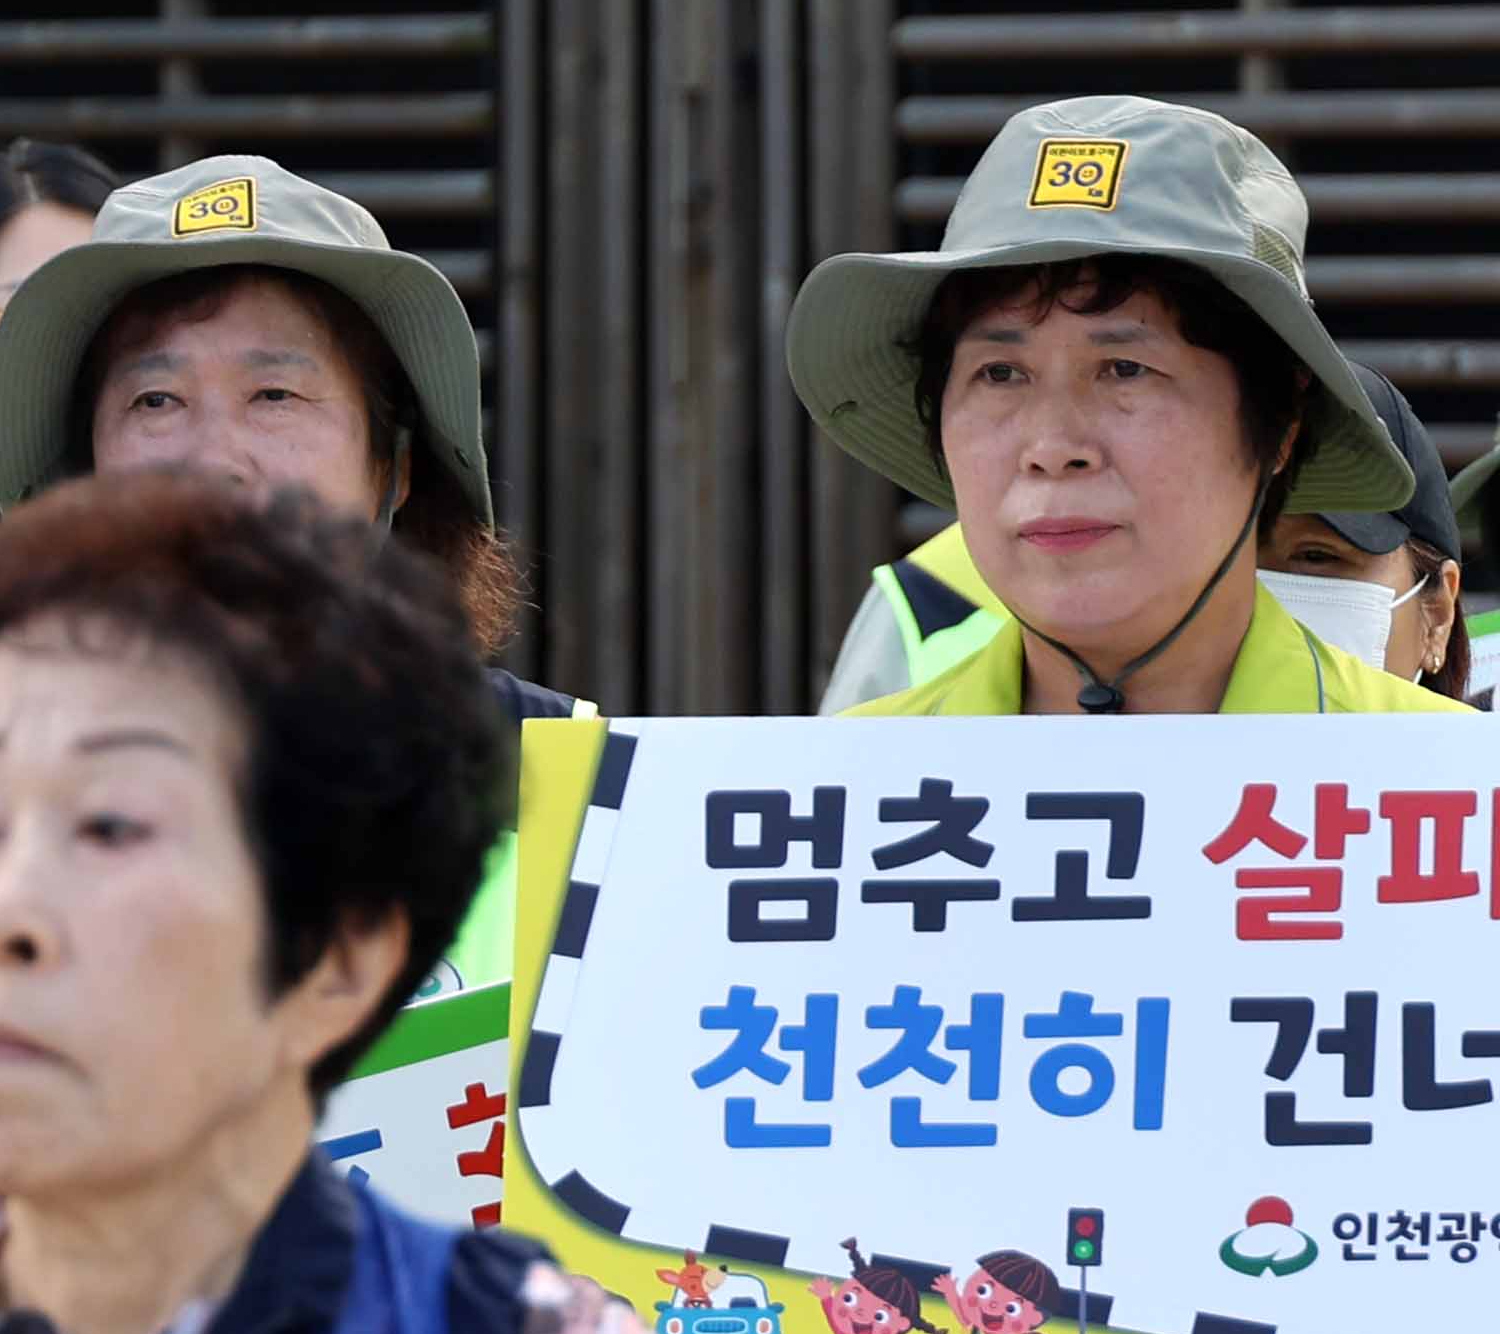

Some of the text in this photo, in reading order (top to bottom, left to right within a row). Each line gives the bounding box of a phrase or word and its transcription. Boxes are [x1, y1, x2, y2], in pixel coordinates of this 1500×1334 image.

[1048, 161, 1104, 187] 30
[188, 196, 239, 219] 30
[705, 779, 1152, 943] 멈추고
[691, 984, 1171, 1149] 천천히
[1333, 1209, 1500, 1264] 인천광
